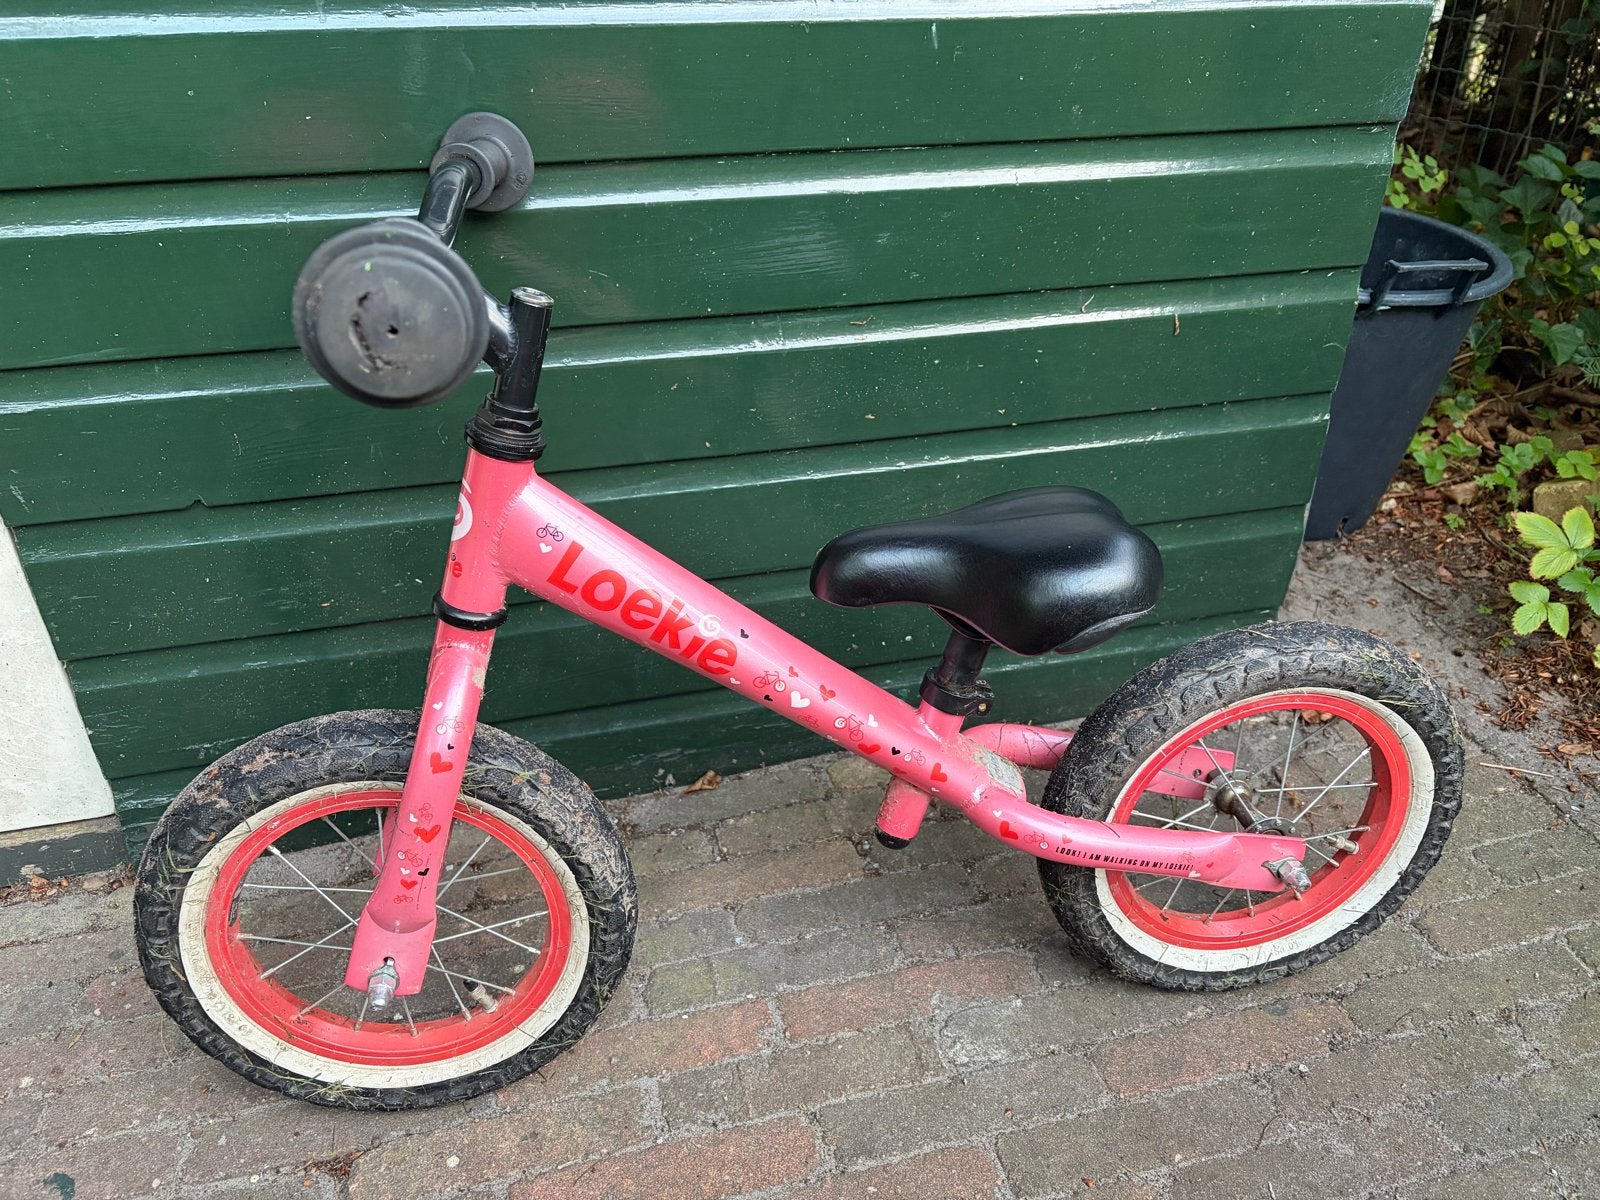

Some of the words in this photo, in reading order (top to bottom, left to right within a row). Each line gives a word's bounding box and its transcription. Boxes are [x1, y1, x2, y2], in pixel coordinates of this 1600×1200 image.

[546, 540, 738, 676] Loekie
[1055, 846, 1081, 858] LOOK!
[1088, 853, 1101, 861] AM
[1103, 855, 1138, 866] WALKING
[1139, 860, 1150, 868] ON
[1151, 861, 1164, 869] MY
